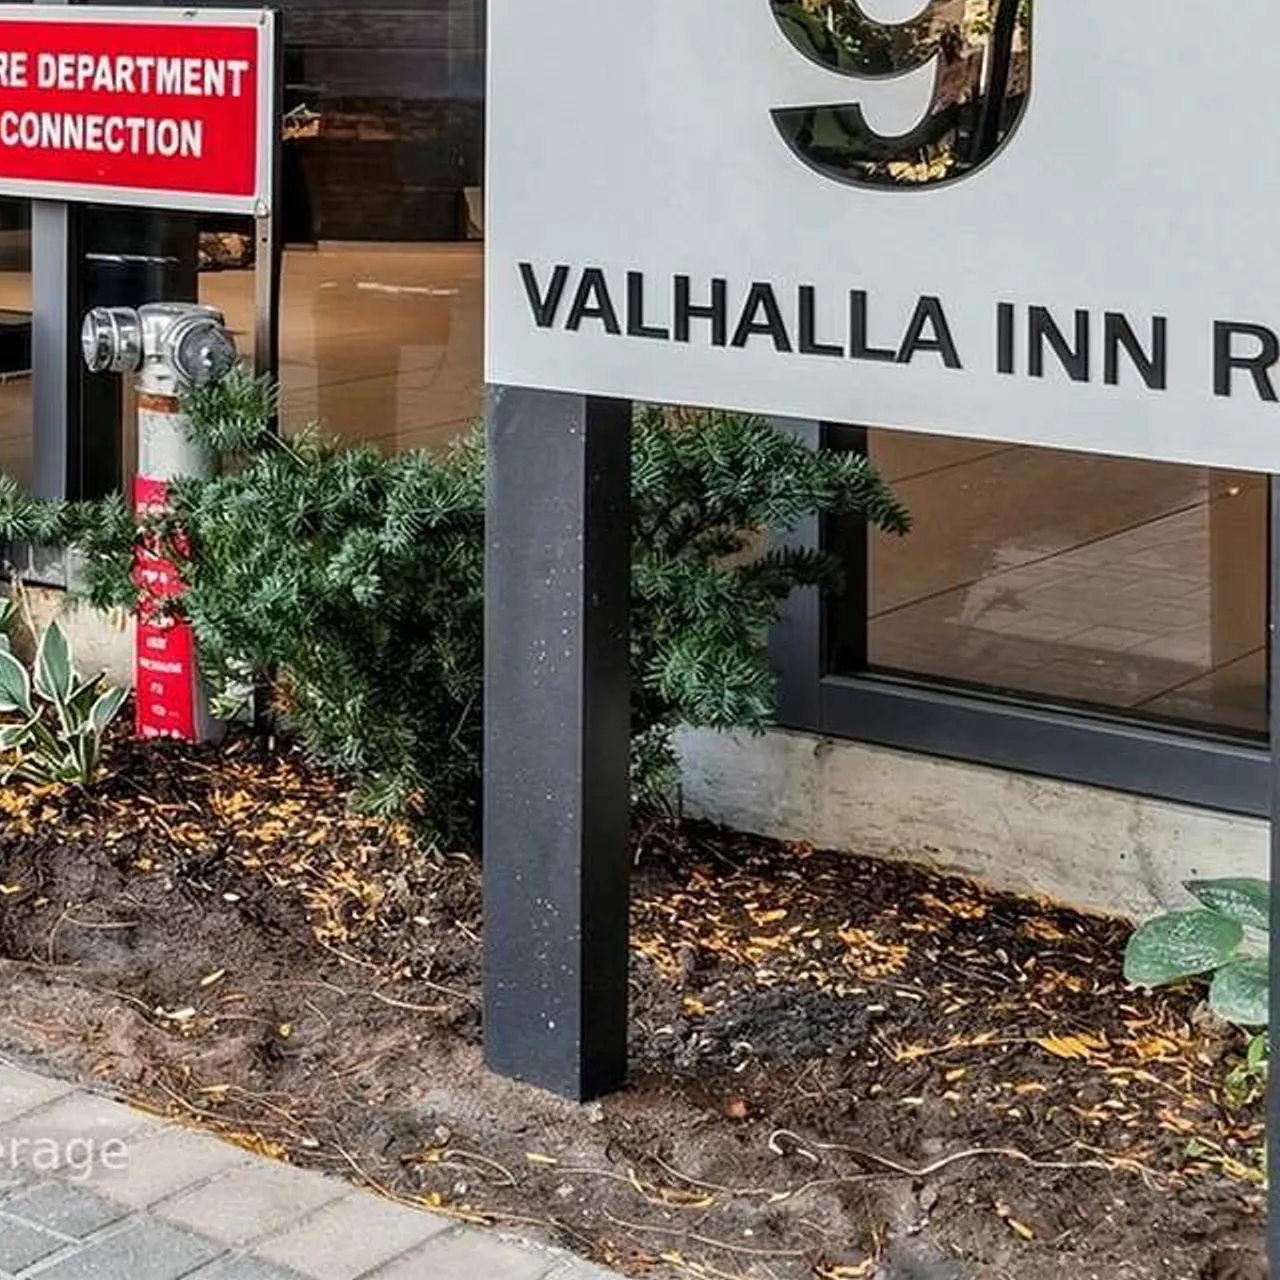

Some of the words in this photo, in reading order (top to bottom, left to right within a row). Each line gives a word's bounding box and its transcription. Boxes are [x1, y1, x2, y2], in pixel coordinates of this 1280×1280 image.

[37, 52, 249, 97] DEPARTMENT
[0, 110, 203, 158] CONNECTION
[519, 261, 963, 370] VALHALLA
[996, 300, 1168, 391] INN
